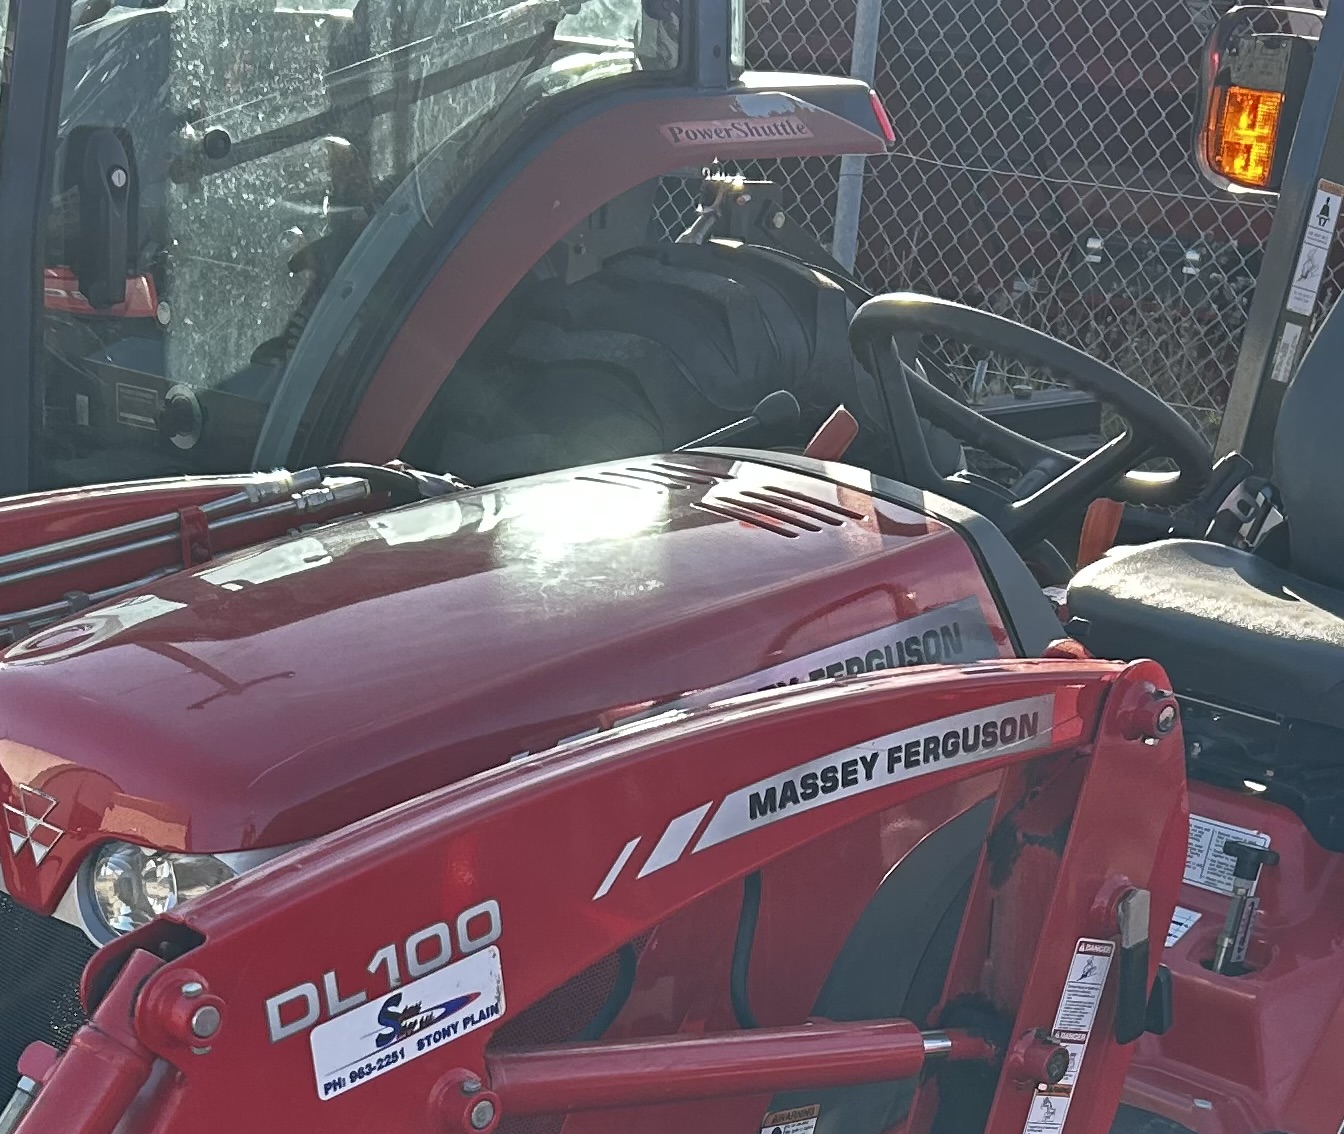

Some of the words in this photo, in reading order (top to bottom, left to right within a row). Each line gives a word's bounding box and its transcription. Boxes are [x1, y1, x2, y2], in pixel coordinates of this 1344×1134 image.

[668, 119, 807, 143] PowerShuttle
[749, 751, 880, 821] MASSEY
[887, 711, 1039, 774] FERGUSON
[265, 899, 502, 1044] DL100
[417, 1021, 459, 1052] STONY
[462, 1002, 500, 1032] PLAIN
